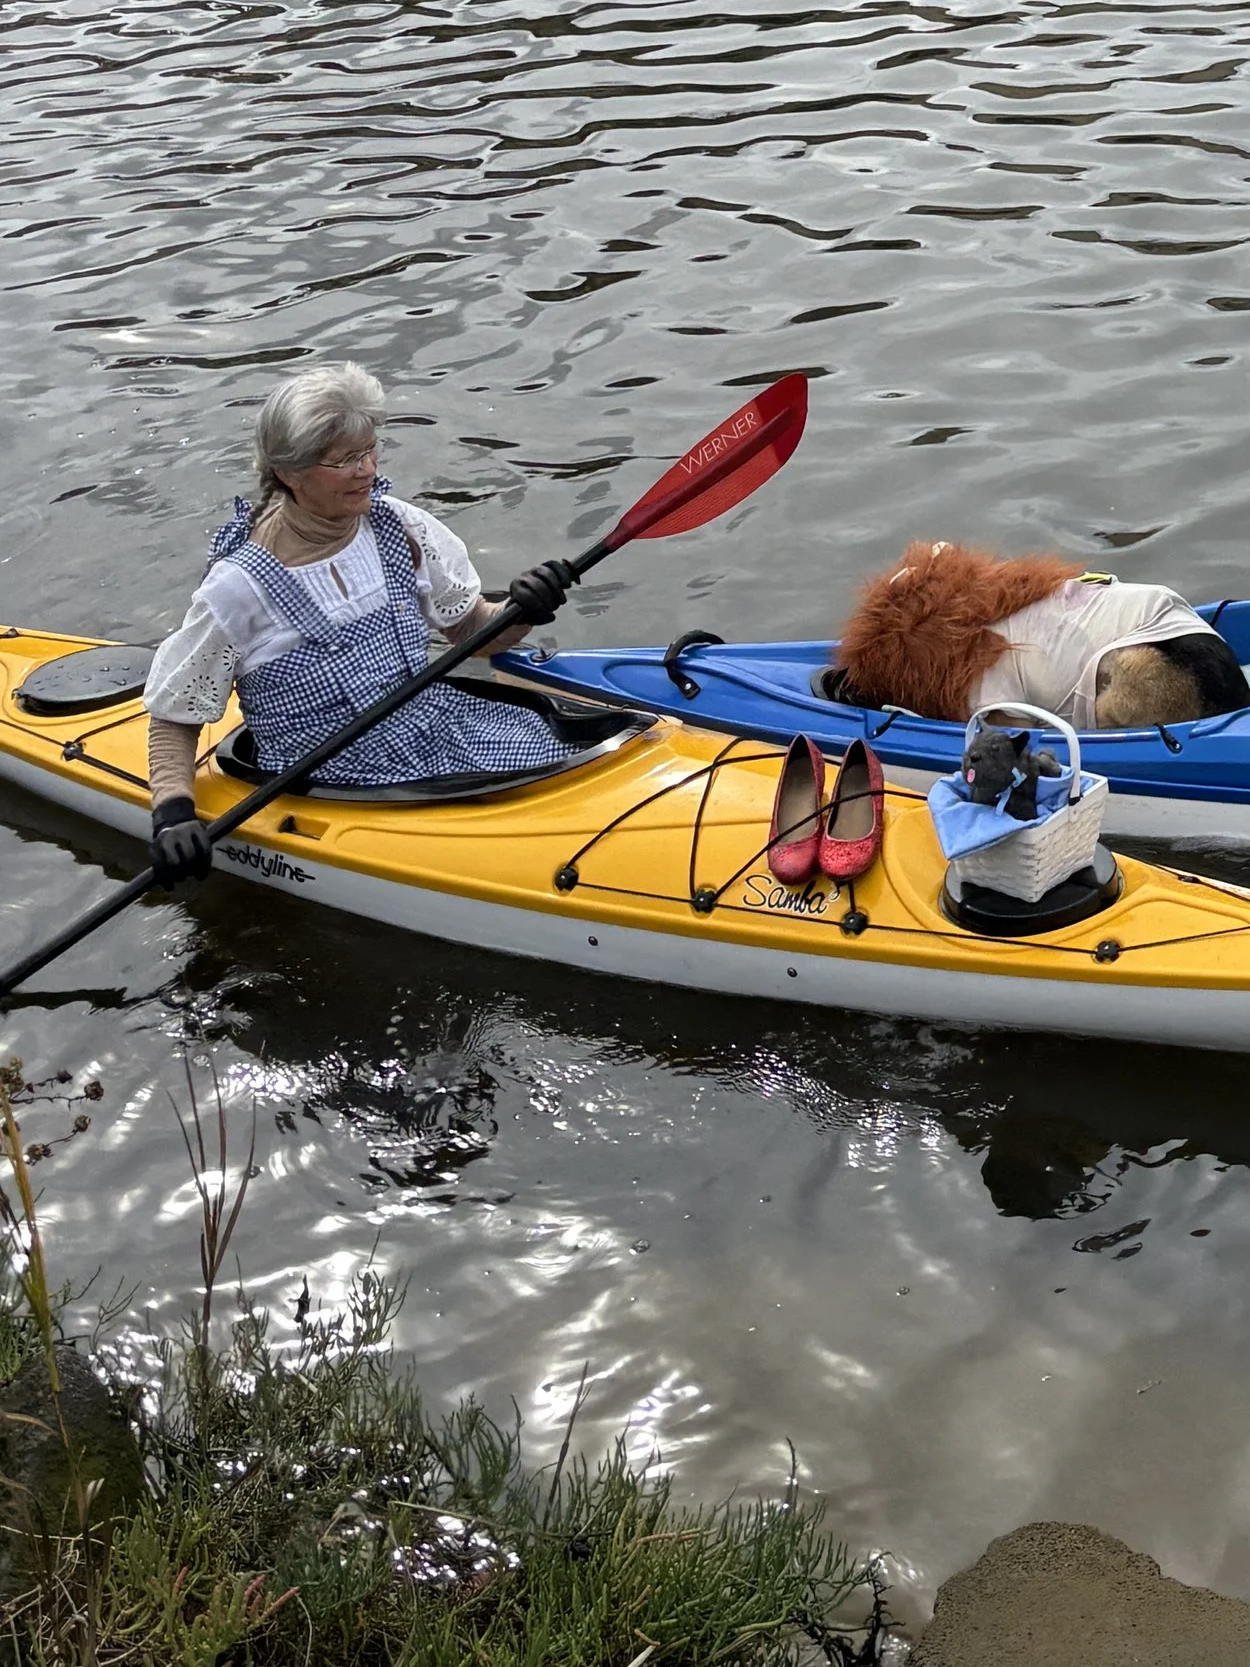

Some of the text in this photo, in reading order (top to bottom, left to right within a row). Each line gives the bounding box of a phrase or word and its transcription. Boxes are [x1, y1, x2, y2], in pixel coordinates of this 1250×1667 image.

[680, 412, 757, 474] WERNER
[216, 844, 316, 882] eddyline
[743, 873, 828, 915] Samba
